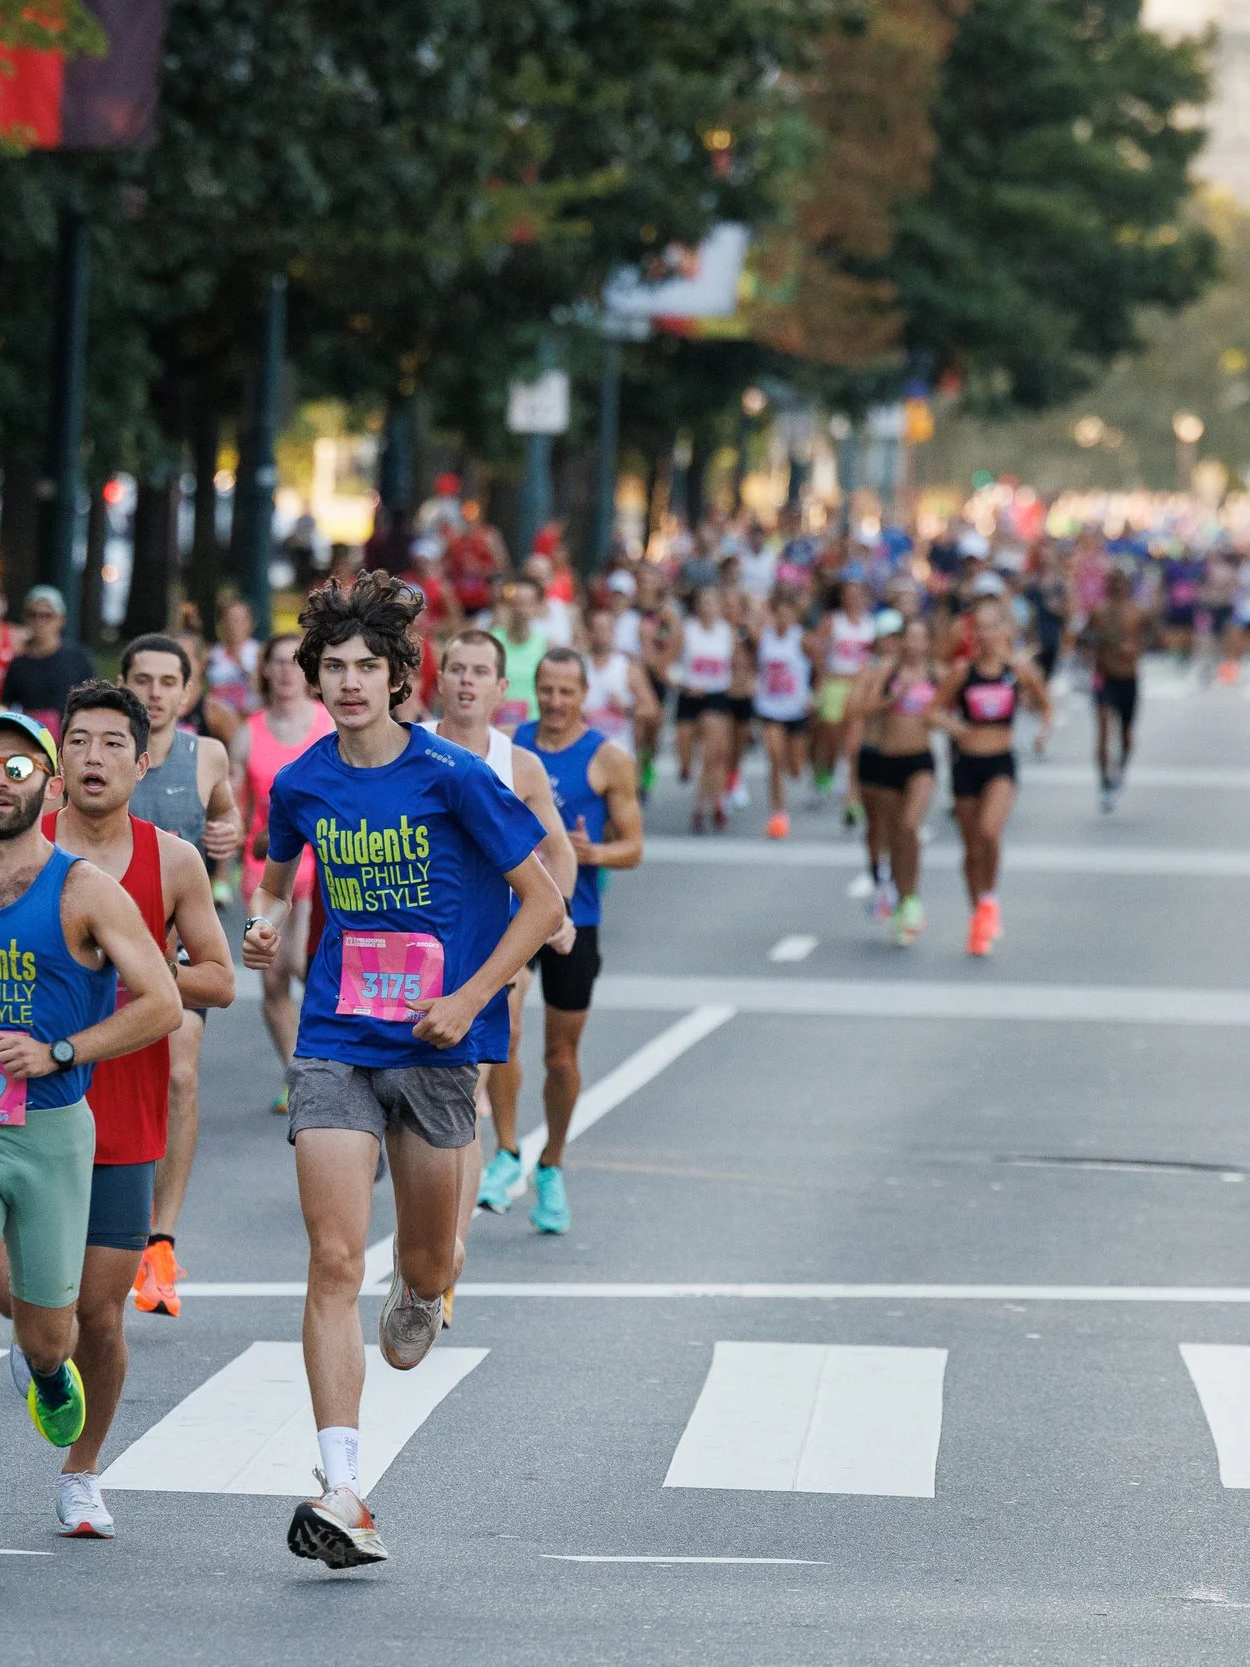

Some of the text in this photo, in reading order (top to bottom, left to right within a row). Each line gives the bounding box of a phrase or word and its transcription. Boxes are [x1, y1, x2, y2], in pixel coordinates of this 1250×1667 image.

[316, 815, 430, 865] Students
[324, 865, 364, 911] Run
[361, 860, 431, 888] PHILLY
[364, 884, 432, 912] STYLE
[360, 972, 421, 1000] 3175
